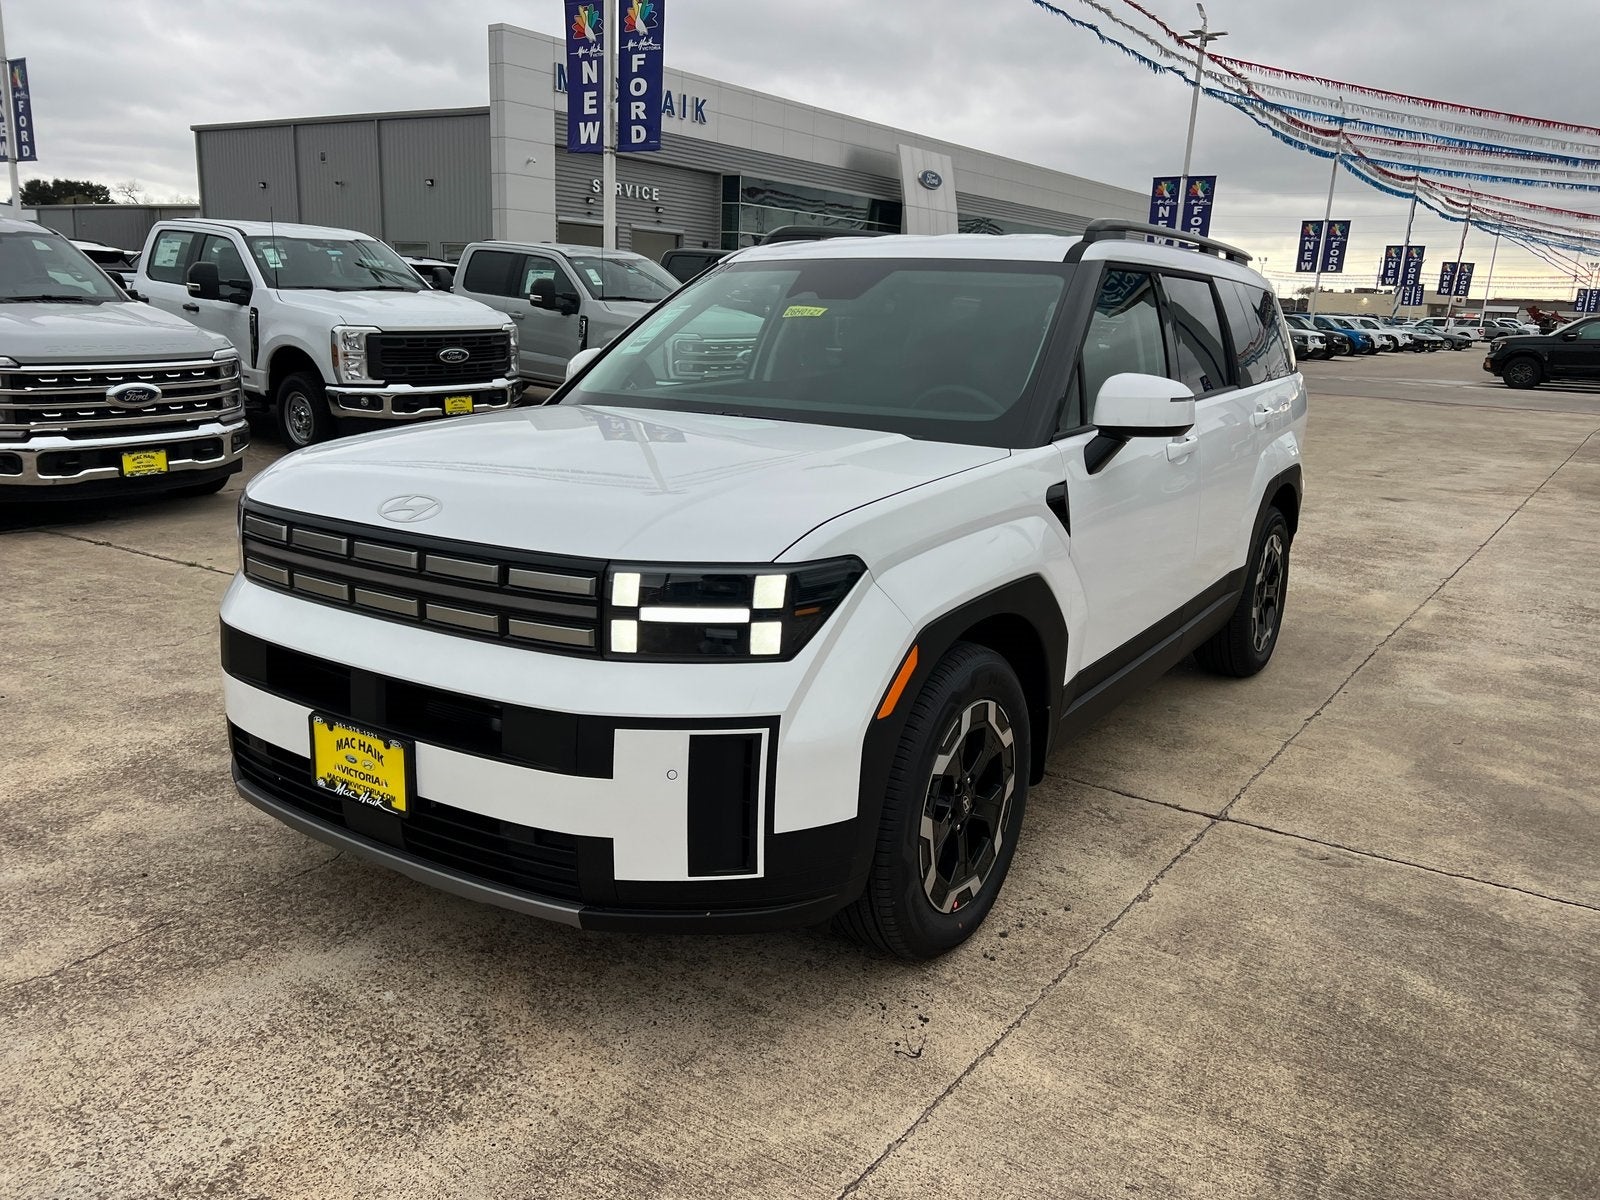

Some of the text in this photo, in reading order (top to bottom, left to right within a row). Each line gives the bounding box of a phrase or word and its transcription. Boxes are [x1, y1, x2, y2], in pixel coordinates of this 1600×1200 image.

[579, 60, 600, 145] NEW
[629, 53, 648, 144] FORD
[661, 90, 707, 124] AIK
[18, 101, 30, 157] FORD
[592, 179, 660, 200] SRVICE
[1189, 206, 1203, 236] FOR
[1301, 241, 1314, 271] NEW
[1328, 241, 1340, 271] FORD
[1385, 261, 1396, 285] NEW
[1407, 261, 1416, 285] FORD
[1440, 274, 1451, 294] NEW
[1458, 275, 1467, 295] FORD
[447, 351, 463, 360] Ford
[124, 389, 149, 401] Ford
[336, 737, 356, 752] MAC
[358, 739, 384, 767] HAIK
[326, 772, 396, 802] MACHAIKVICTORIACOM
[340, 765, 382, 785] VICTORIA
[334, 782, 388, 809] Mac Haik
